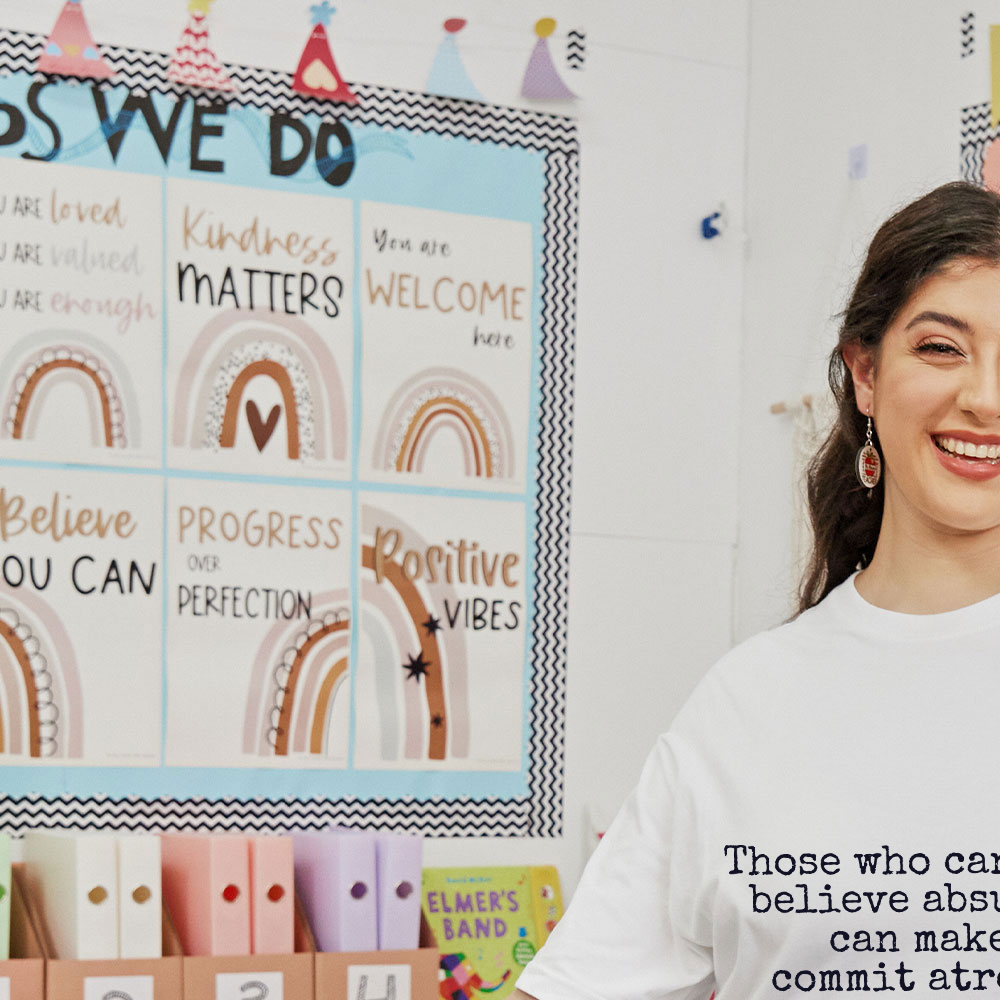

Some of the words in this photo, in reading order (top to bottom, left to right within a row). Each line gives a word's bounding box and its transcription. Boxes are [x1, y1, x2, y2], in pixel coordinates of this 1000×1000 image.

[91, 84, 225, 173] WE
[269, 111, 357, 188] DO
[51, 188, 127, 228] loved
[182, 205, 340, 266] Kindness
[419, 239, 452, 257] are
[365, 268, 526, 321] WELCOME
[51, 291, 156, 334] enough
[473, 325, 516, 350] here
[0, 488, 137, 544] Believe
[178, 506, 343, 549] PROGRESS
[187, 553, 221, 572] OVER
[373, 527, 521, 588] Positive
[1, 555, 51, 591] OU
[72, 555, 156, 596] CAN
[178, 584, 312, 621] PERFECTION
[443, 598, 522, 631] VIBES
[723, 844, 842, 877] Those
[853, 845, 931, 877] who
[427, 891, 519, 914] ELMER'S
[748, 883, 911, 914] believe
[442, 918, 507, 940] BAND
[829, 929, 901, 954] can
[771, 961, 916, 993] commit
